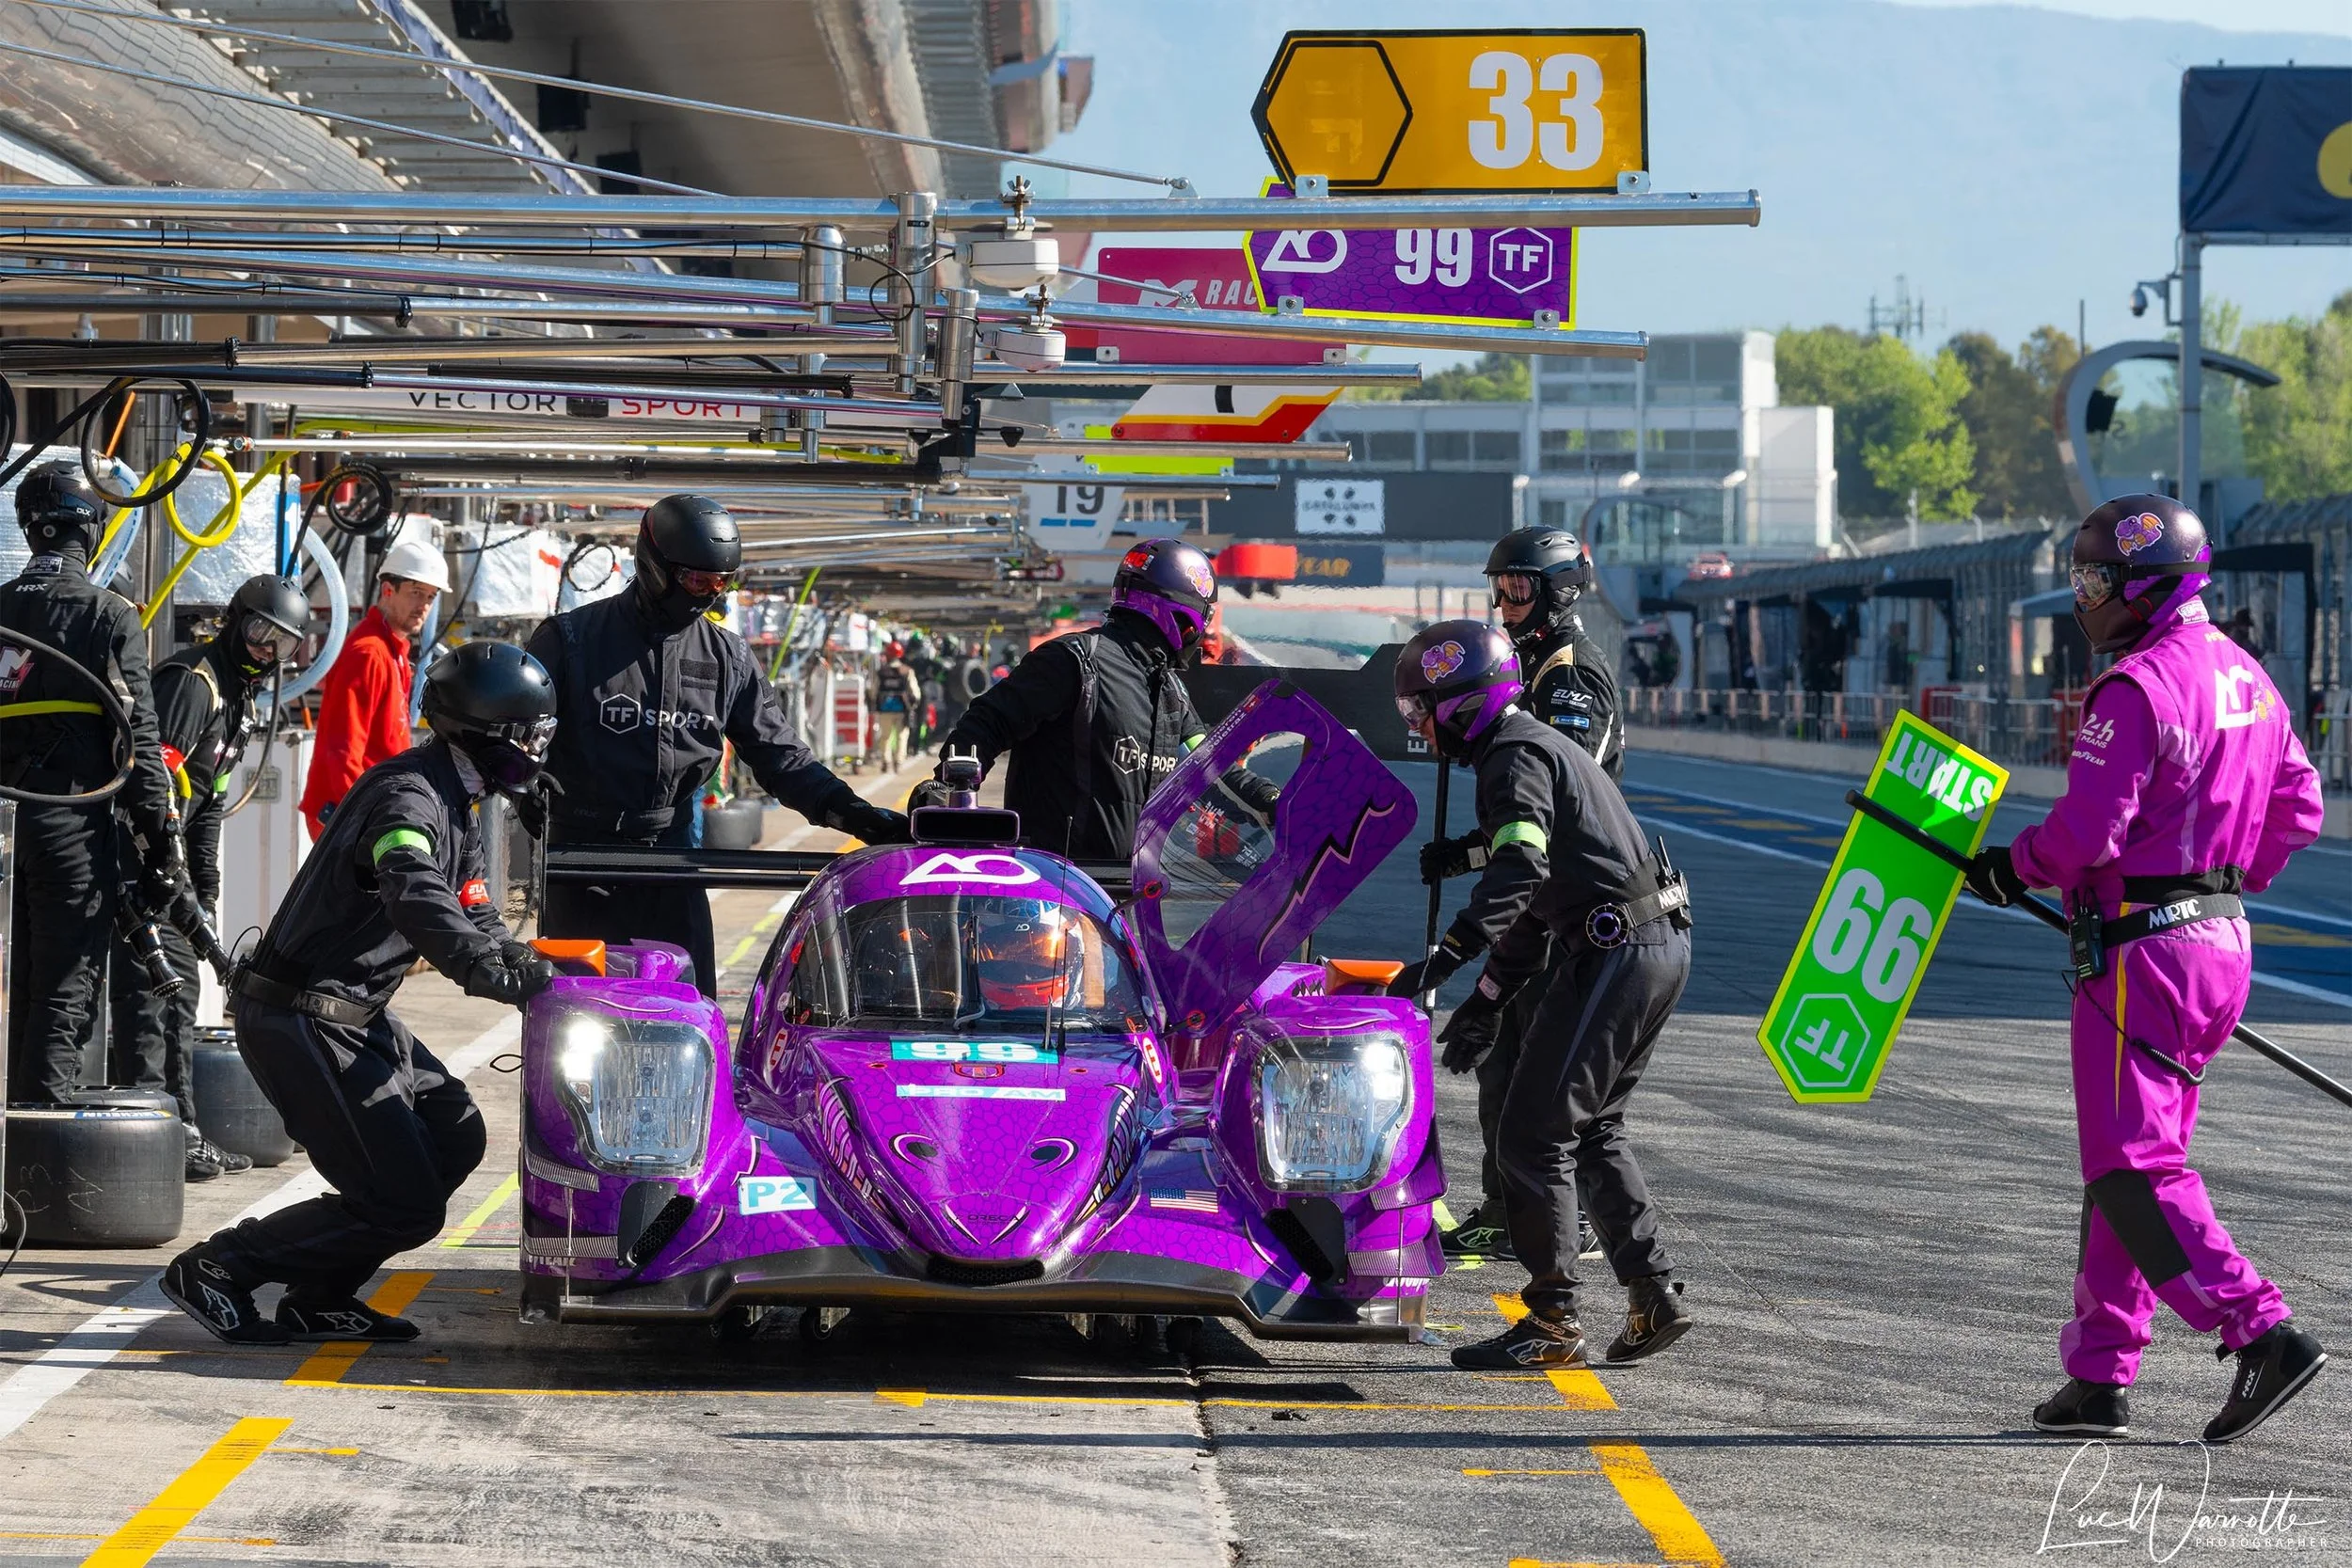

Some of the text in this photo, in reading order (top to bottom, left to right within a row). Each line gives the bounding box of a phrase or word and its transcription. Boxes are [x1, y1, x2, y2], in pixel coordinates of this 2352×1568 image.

[1468, 51, 1604, 171] 33
[1394, 229, 1472, 287] 99
[1499, 244, 1543, 272] TF
[1205, 279, 1258, 305] RAC
[1057, 485, 1105, 515] 19
[16, 583, 48, 593] HRX
[606, 706, 715, 731] TF SPORT
[1120, 746, 1178, 772] TF SPOR
[1885, 731, 1994, 822] START
[2149, 898, 2202, 929] MRTC
[910, 1041, 1038, 1061] 99
[1795, 1018, 1850, 1072] TF
[748, 1181, 808, 1209] P2
